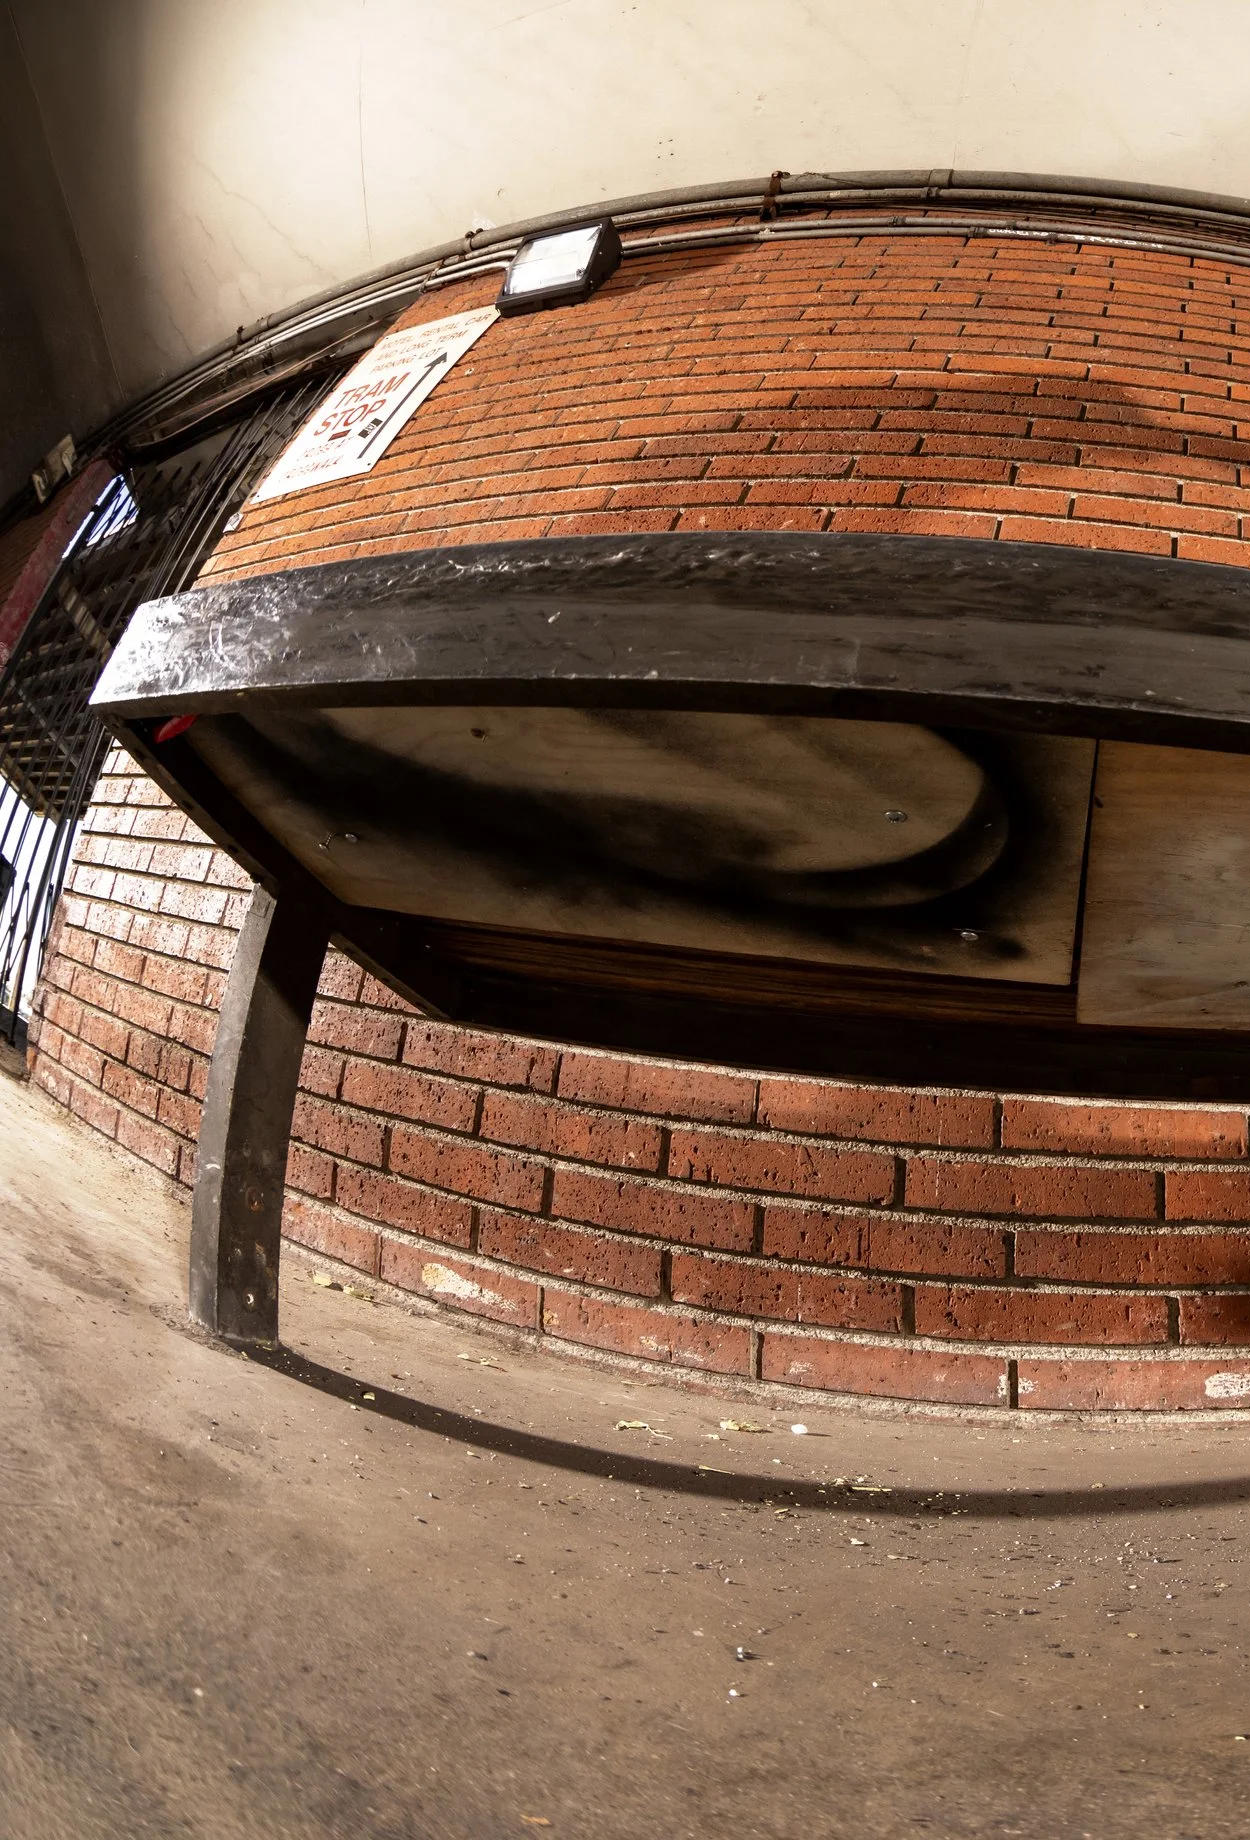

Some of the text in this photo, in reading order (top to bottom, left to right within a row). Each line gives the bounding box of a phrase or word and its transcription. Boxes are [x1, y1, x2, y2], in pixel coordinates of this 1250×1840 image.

[420, 322, 461, 337] RENTAL
[465, 313, 492, 326] CAR
[400, 339, 432, 355] LONG
[436, 329, 469, 344] TERM
[418, 346, 445, 360] LOT
[334, 371, 412, 409] TRAM
[313, 398, 387, 437] STOP
